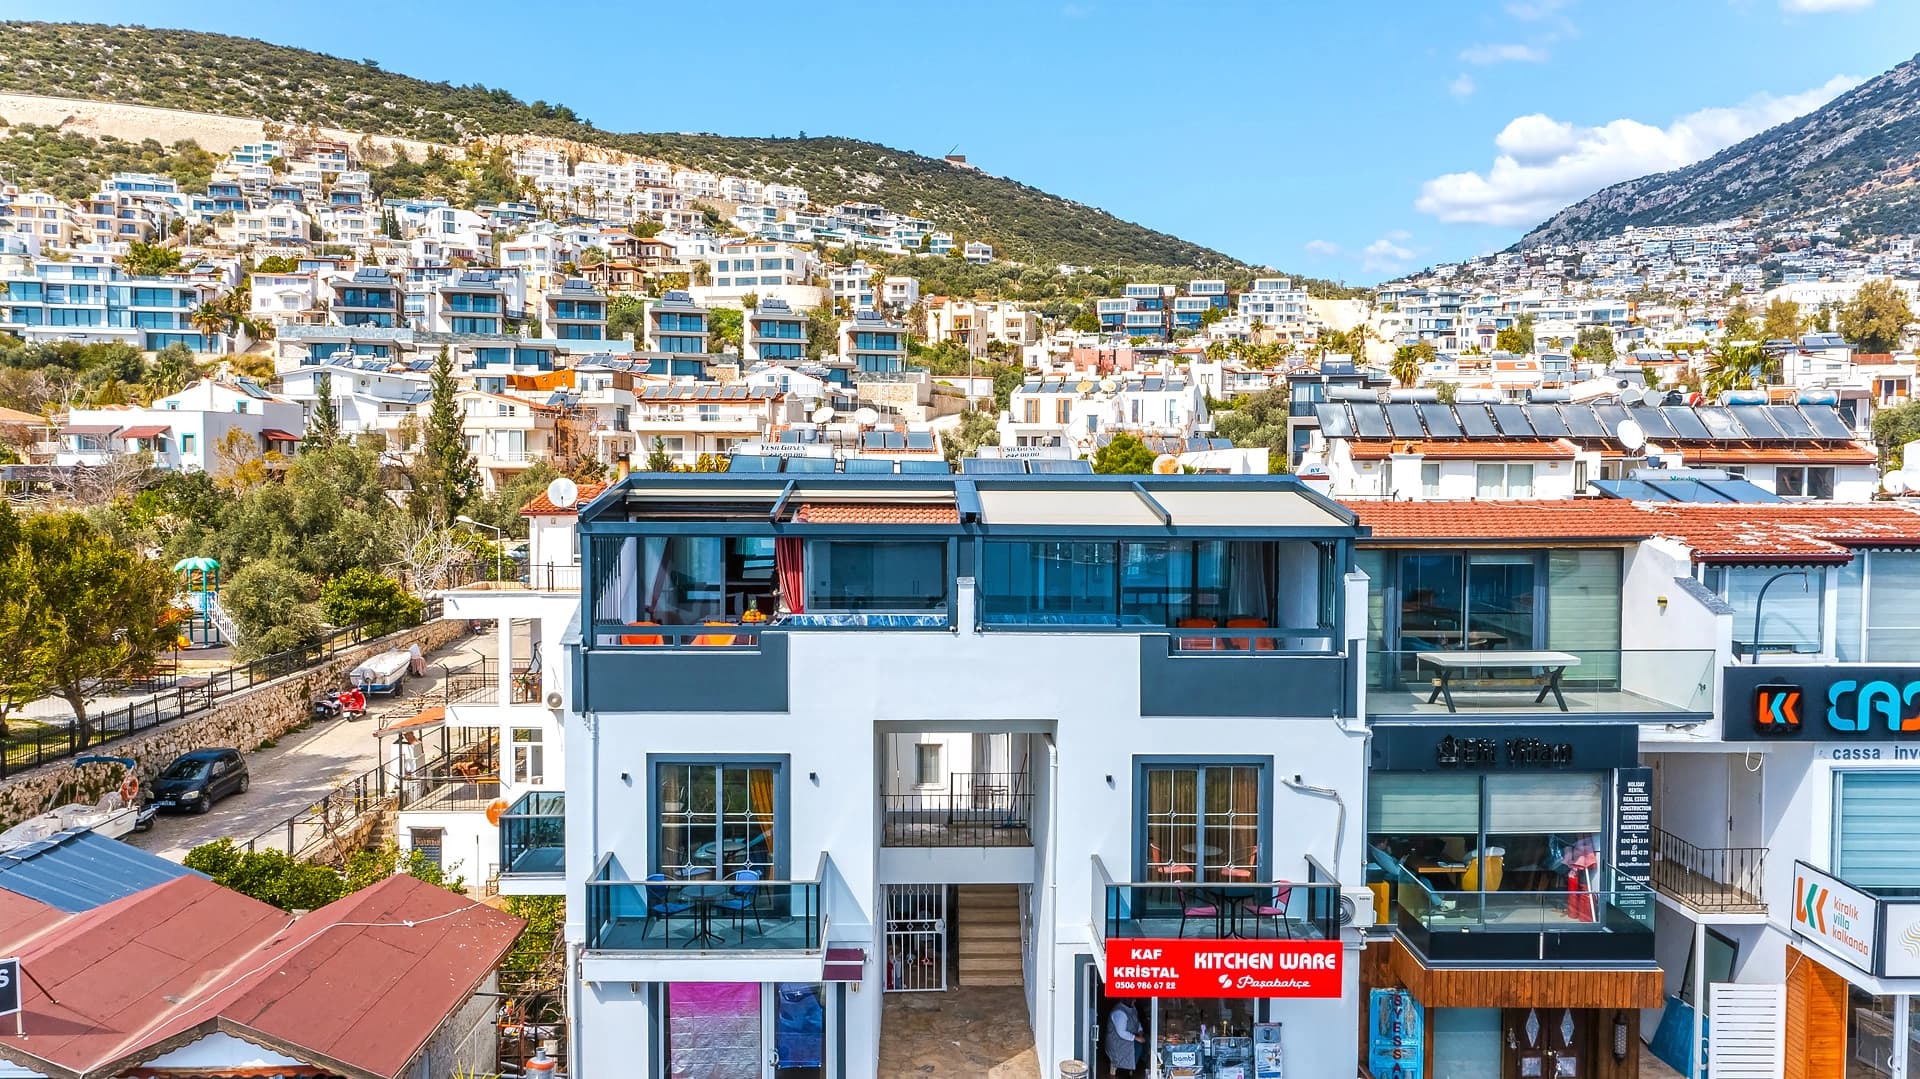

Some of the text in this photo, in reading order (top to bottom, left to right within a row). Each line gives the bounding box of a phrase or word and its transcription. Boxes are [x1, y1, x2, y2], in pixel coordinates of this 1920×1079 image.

[1833, 745, 1920, 760] cassa inv
[1833, 912, 1850, 930] villa
[1832, 925, 1869, 956] kalkanda
[1131, 949, 1162, 960] KAF
[1194, 952, 1336, 970] KITCHEN WARE
[1113, 964, 1180, 978] KRİSTAL
[1236, 975, 1312, 989] Paşabahçe
[1173, 1054, 1195, 1062] bambi
